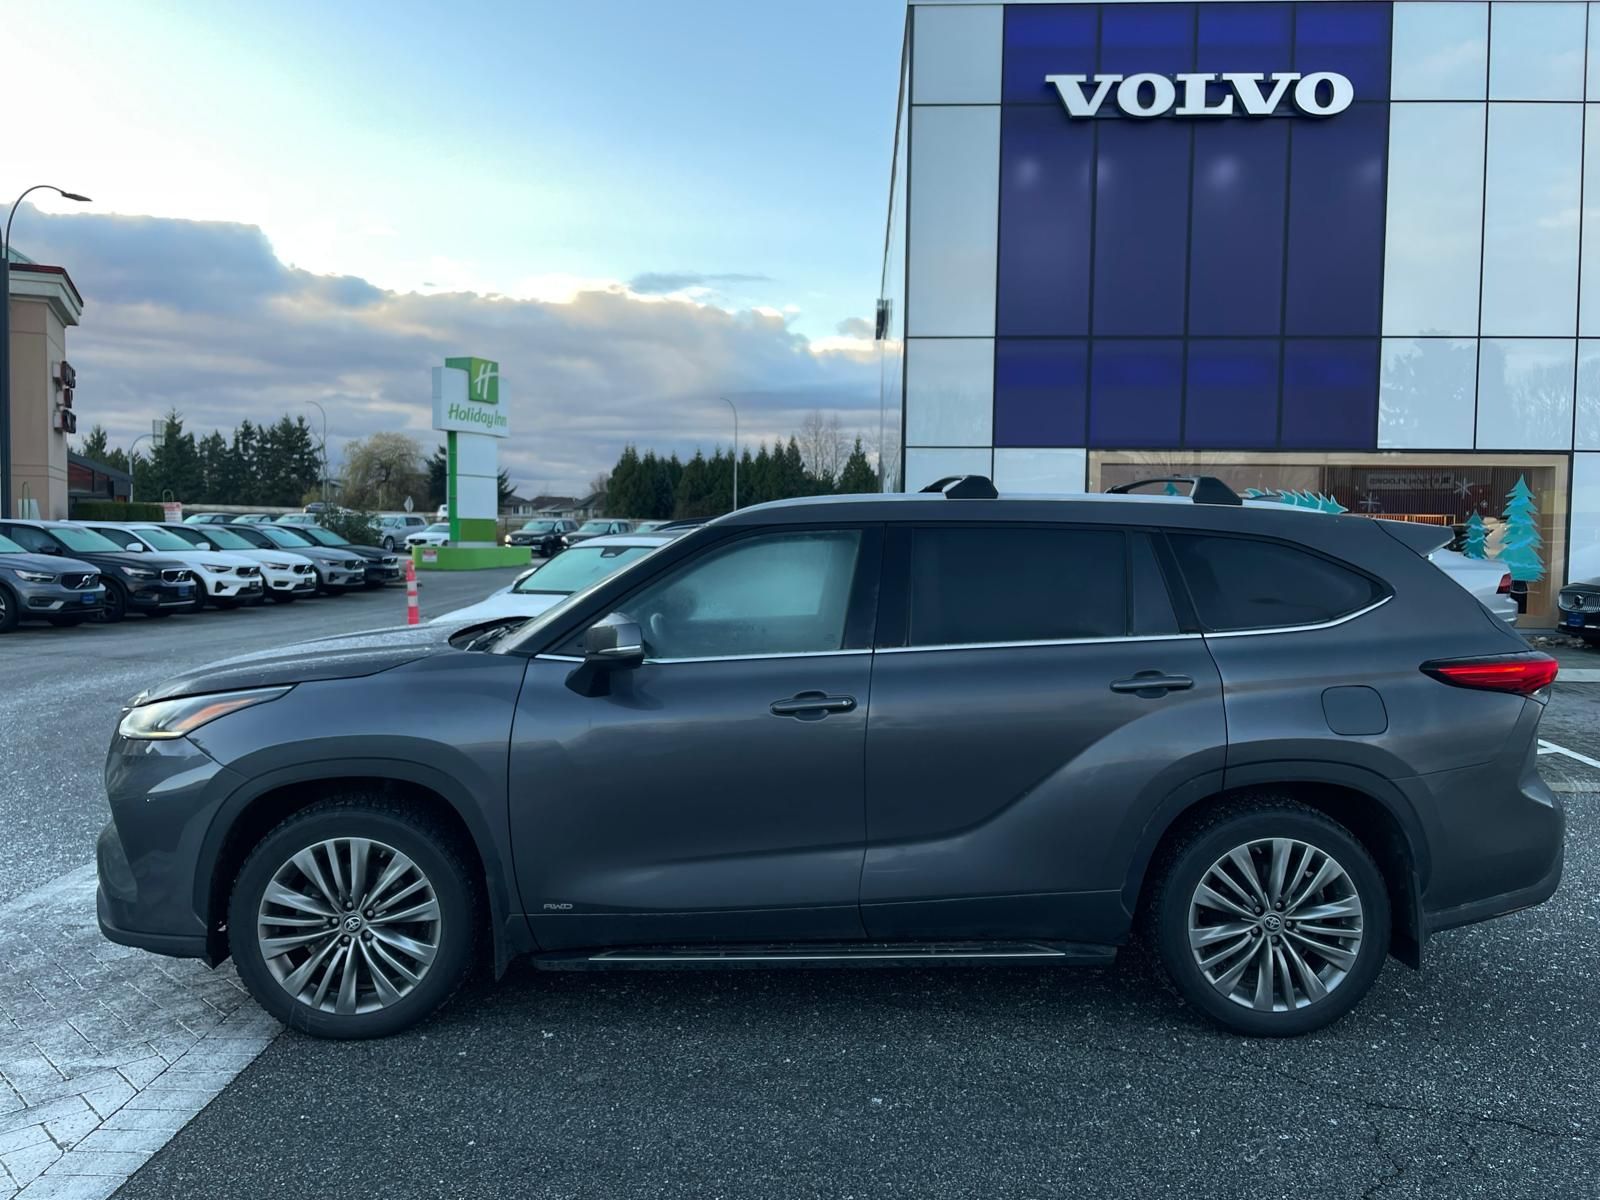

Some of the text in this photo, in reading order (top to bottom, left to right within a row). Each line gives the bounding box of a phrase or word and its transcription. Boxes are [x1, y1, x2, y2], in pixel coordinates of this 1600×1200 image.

[1044, 71, 1355, 117] VOLVO
[447, 403, 507, 429] Holiday Inn
